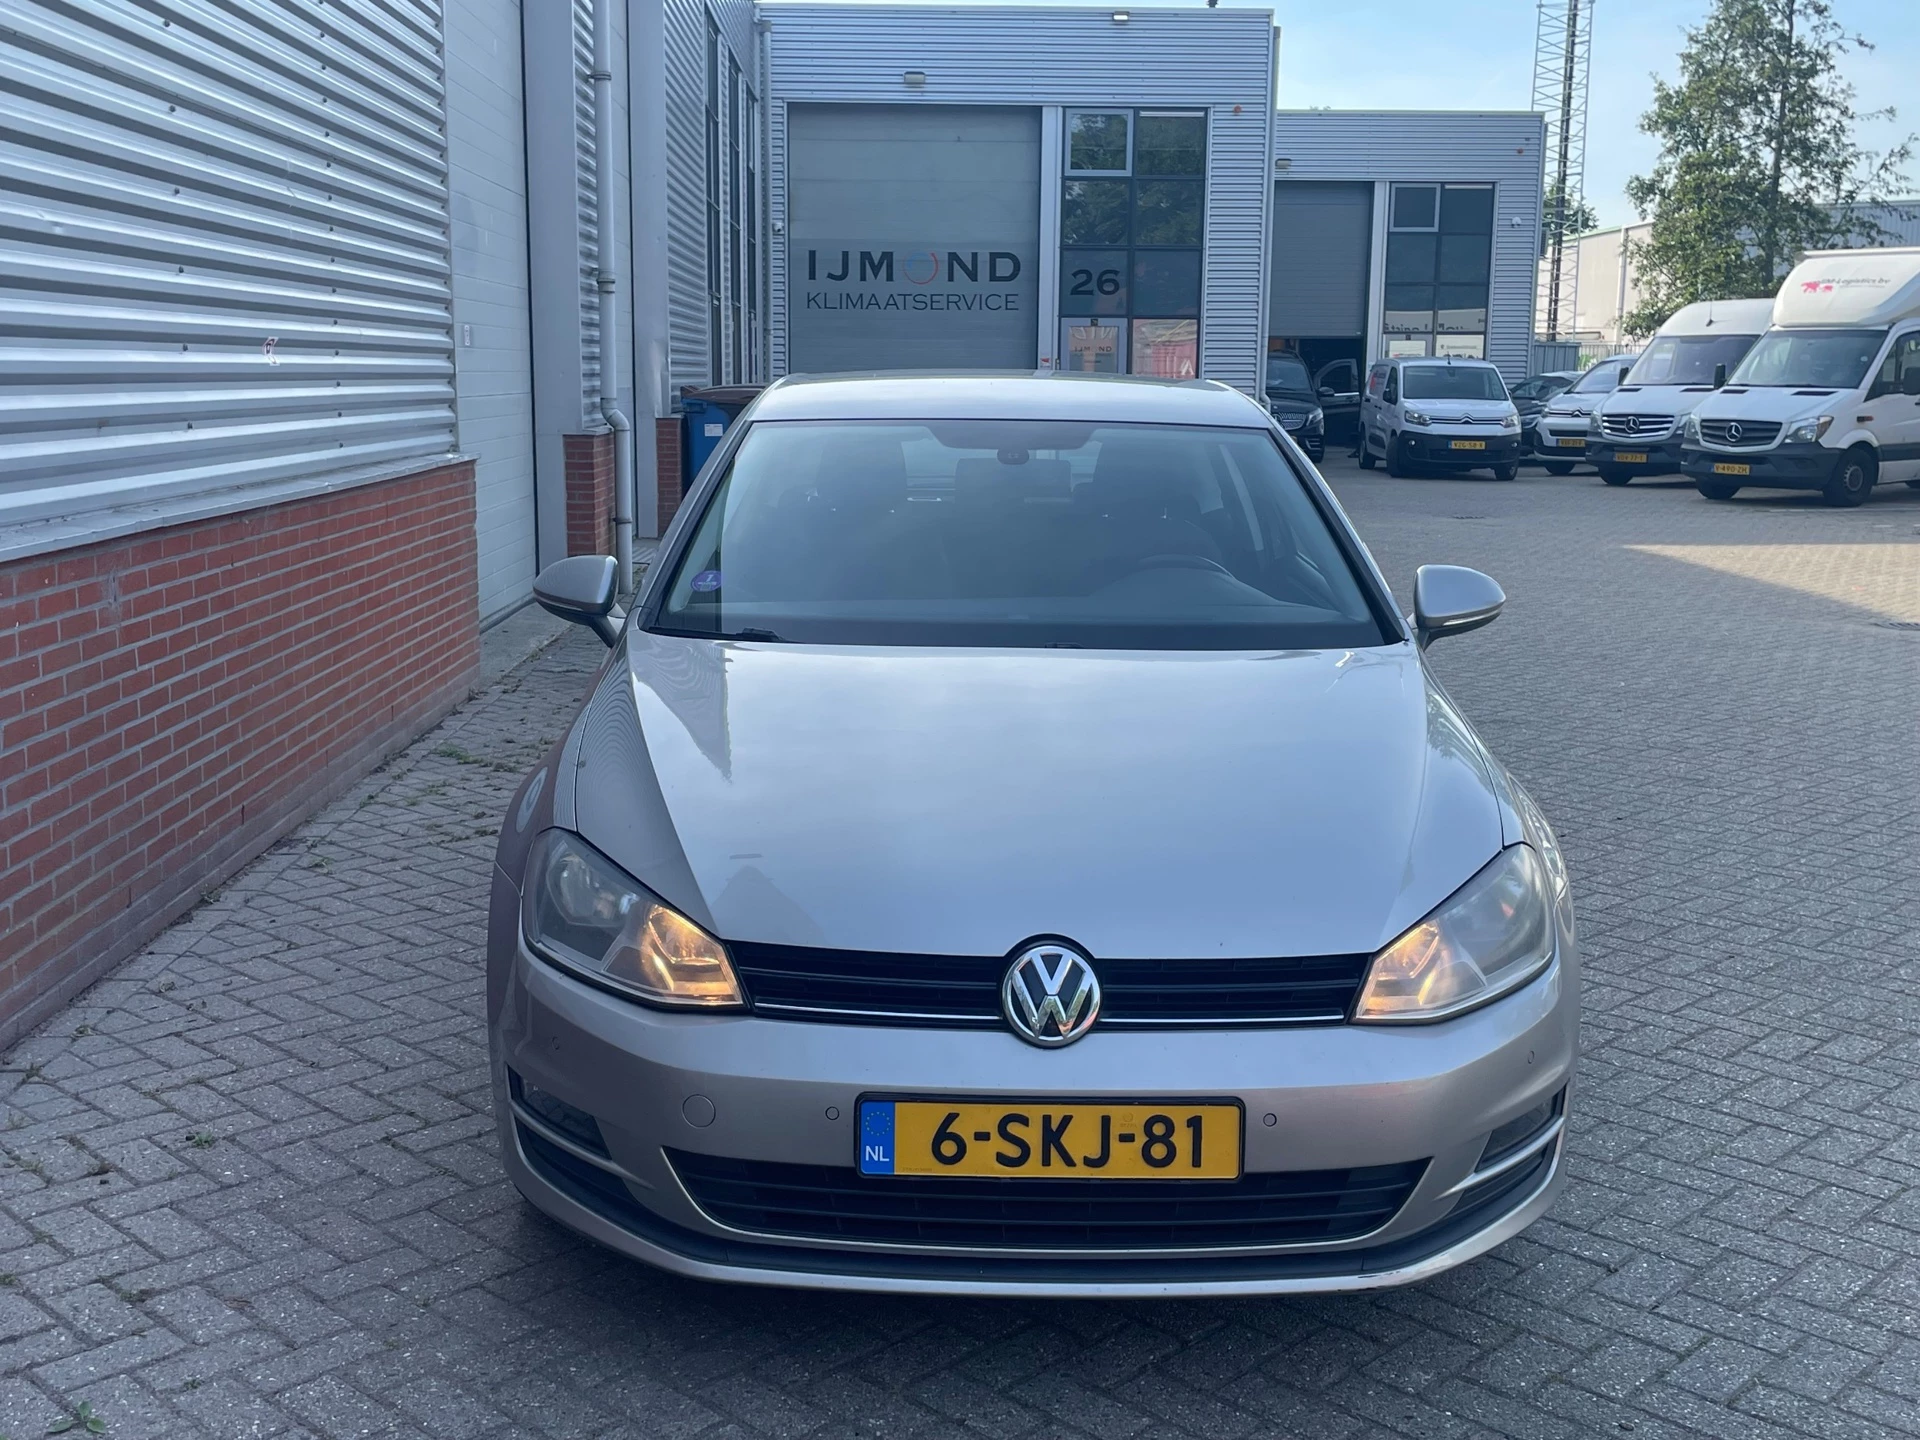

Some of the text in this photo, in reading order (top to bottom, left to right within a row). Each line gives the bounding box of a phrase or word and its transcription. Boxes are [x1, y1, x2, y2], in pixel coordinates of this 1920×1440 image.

[1069, 268, 1121, 297] 26
[806, 291, 1020, 311] KLIMAATSERVICE
[930, 1111, 1204, 1169] 6-SKJ-81
[865, 1145, 890, 1163] NL
